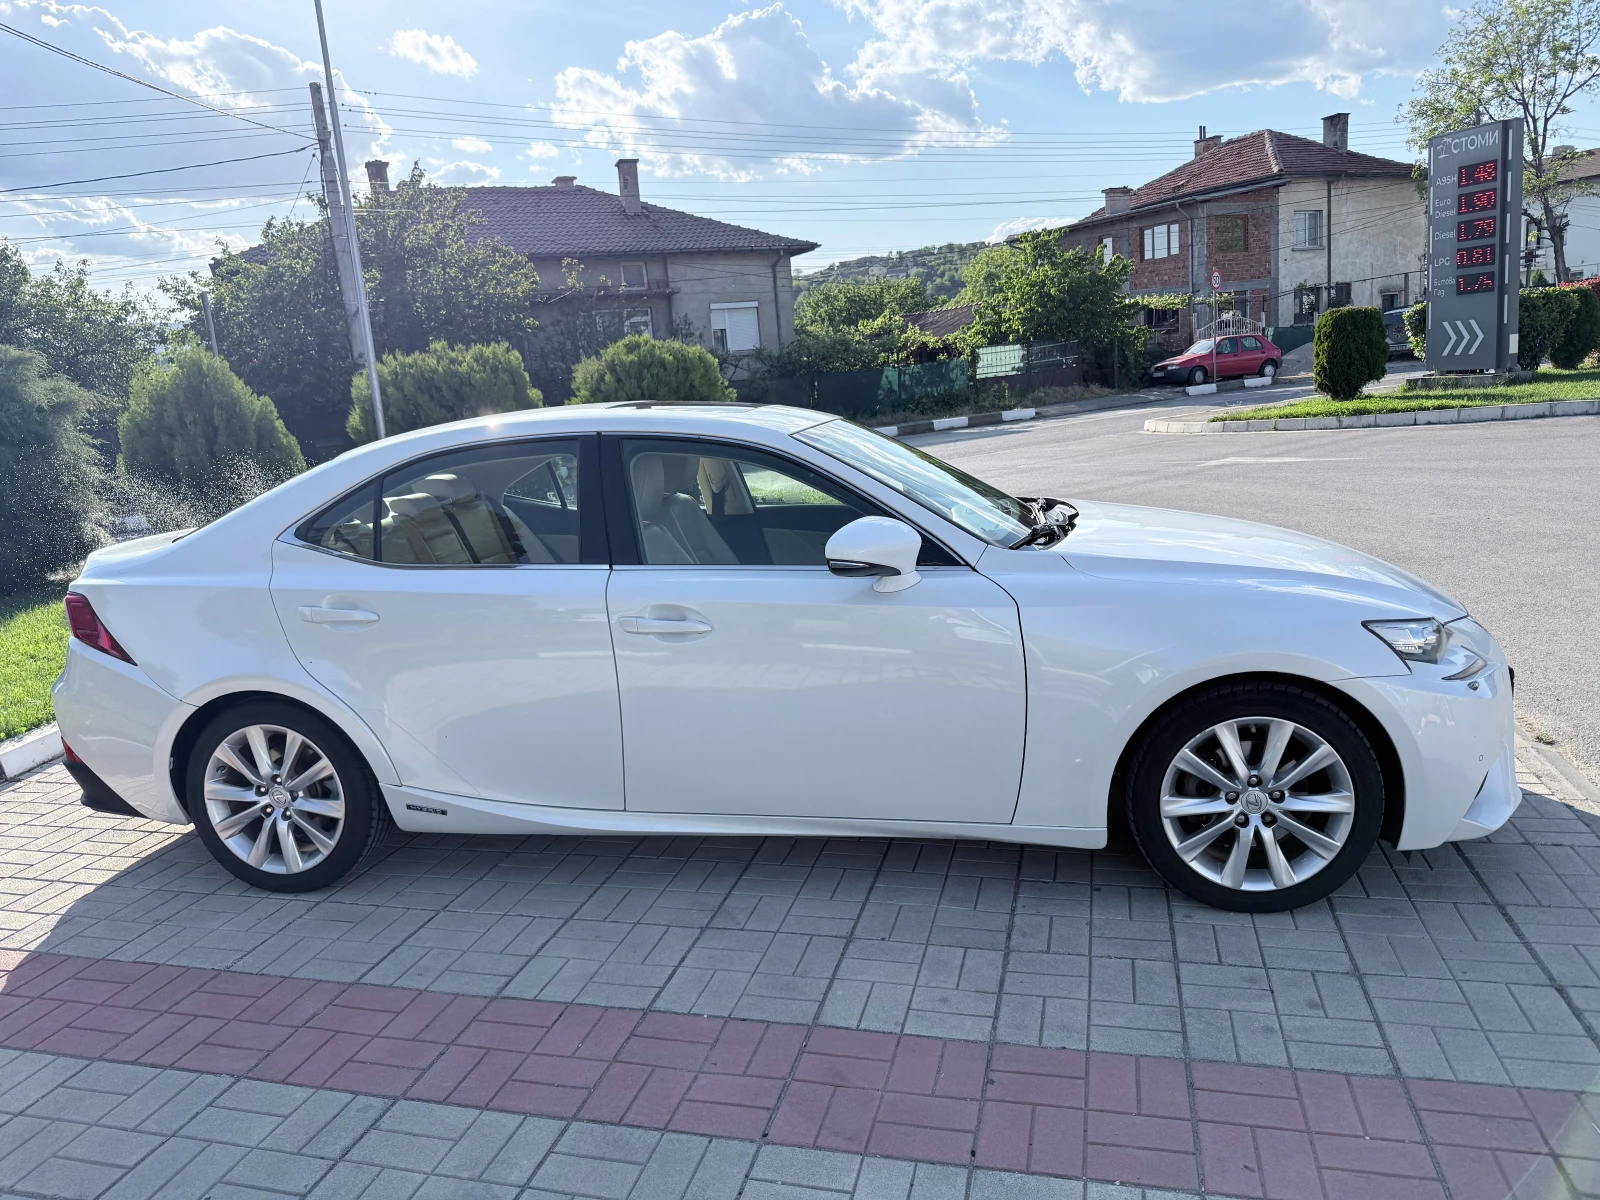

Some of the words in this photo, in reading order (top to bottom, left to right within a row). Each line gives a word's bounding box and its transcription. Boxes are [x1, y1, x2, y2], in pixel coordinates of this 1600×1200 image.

[1451, 129, 1499, 154] СТОМИ
[1435, 198, 1451, 207] Euro
[1459, 191, 1495, 213] 1.90
[1434, 207, 1456, 219] Diesel
[1434, 228, 1456, 241] Diesel
[1458, 219, 1495, 240] 1.79
[1434, 257, 1451, 267] LPG
[1456, 247, 1493, 265] 0.81
